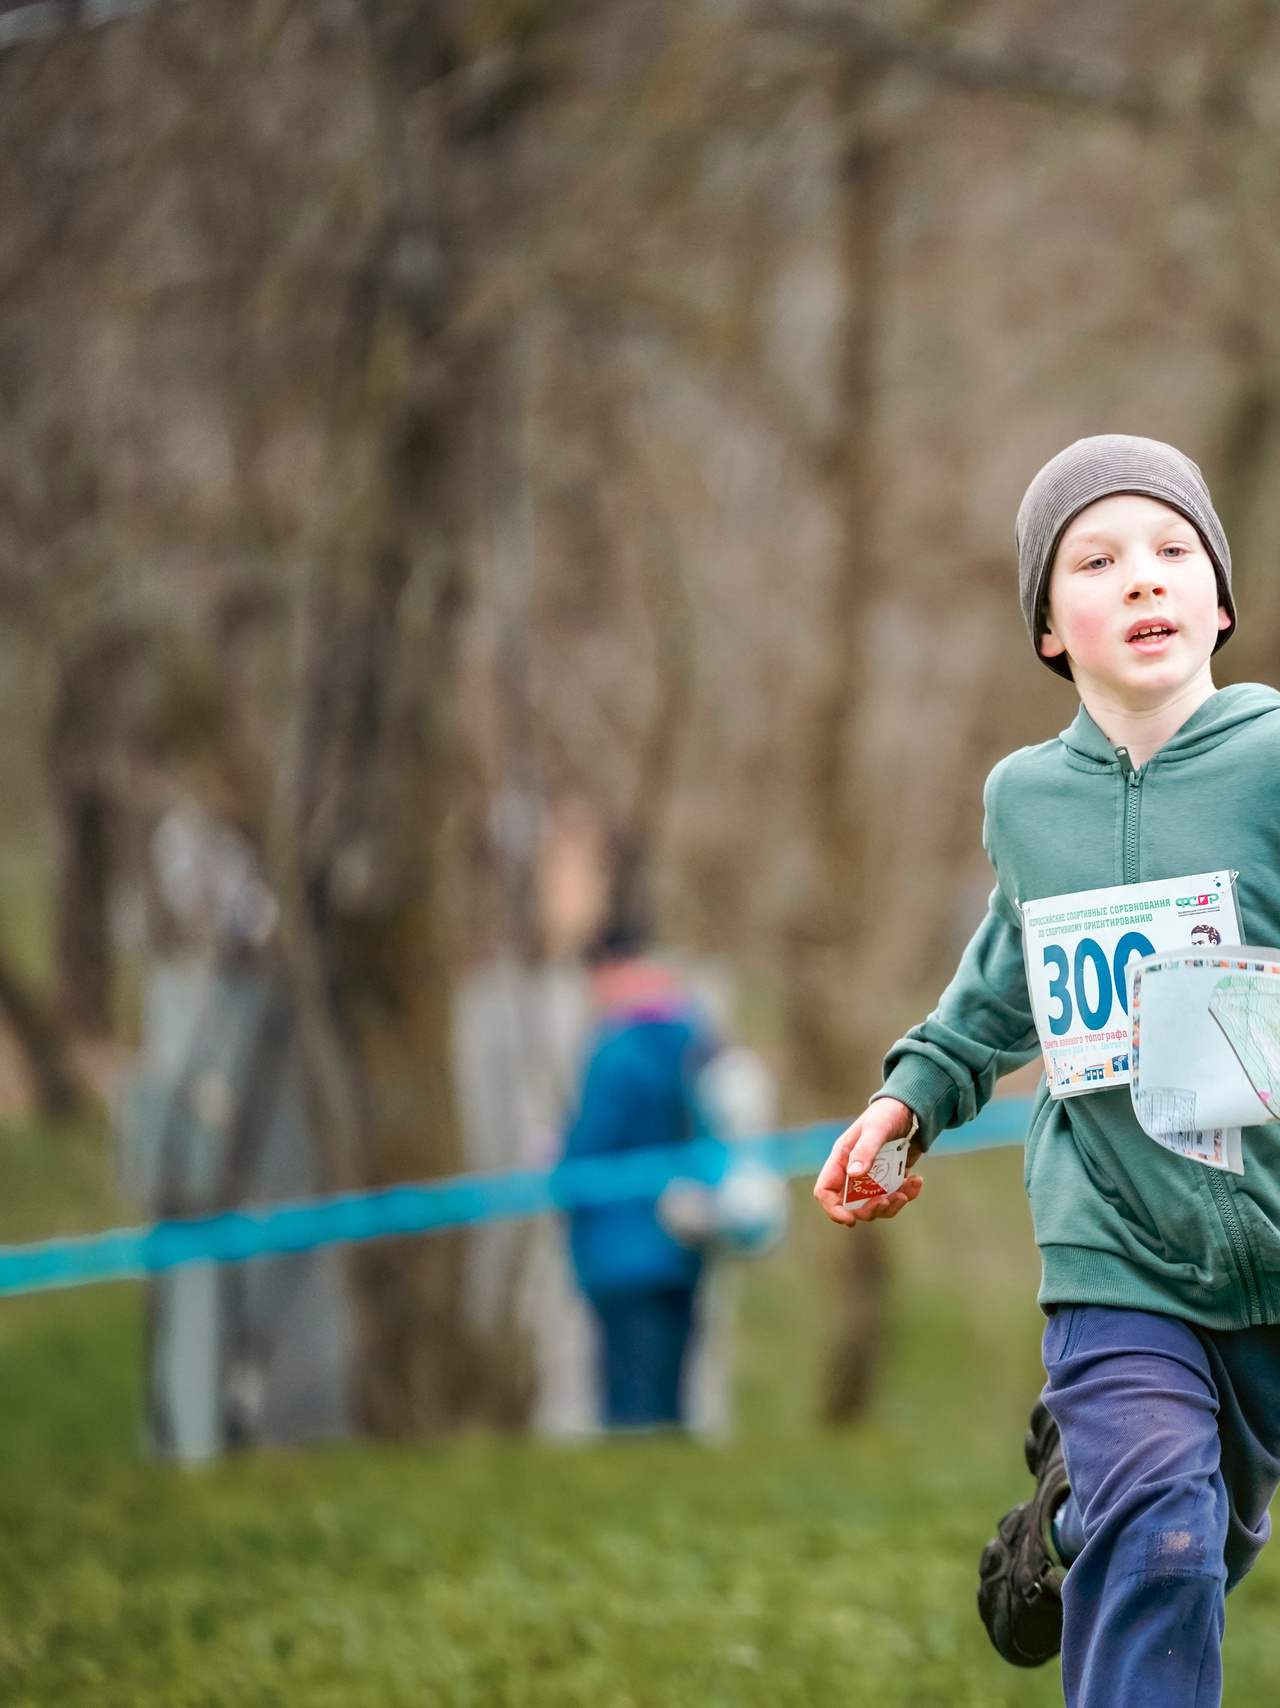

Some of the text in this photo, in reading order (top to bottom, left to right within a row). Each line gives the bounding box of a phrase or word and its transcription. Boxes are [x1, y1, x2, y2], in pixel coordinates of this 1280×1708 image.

[1067, 906, 1108, 921] СПОРТИВНЫЕ
[1110, 898, 1171, 915] СОРЕВНОВАНИЯ
[1046, 922, 1082, 937] СПОРТИВНОМУ
[1084, 913, 1153, 931] ОРИЕНТИРОВАНИЮ
[1060, 1036, 1083, 1047] военного
[1085, 1029, 1128, 1043] топографа
